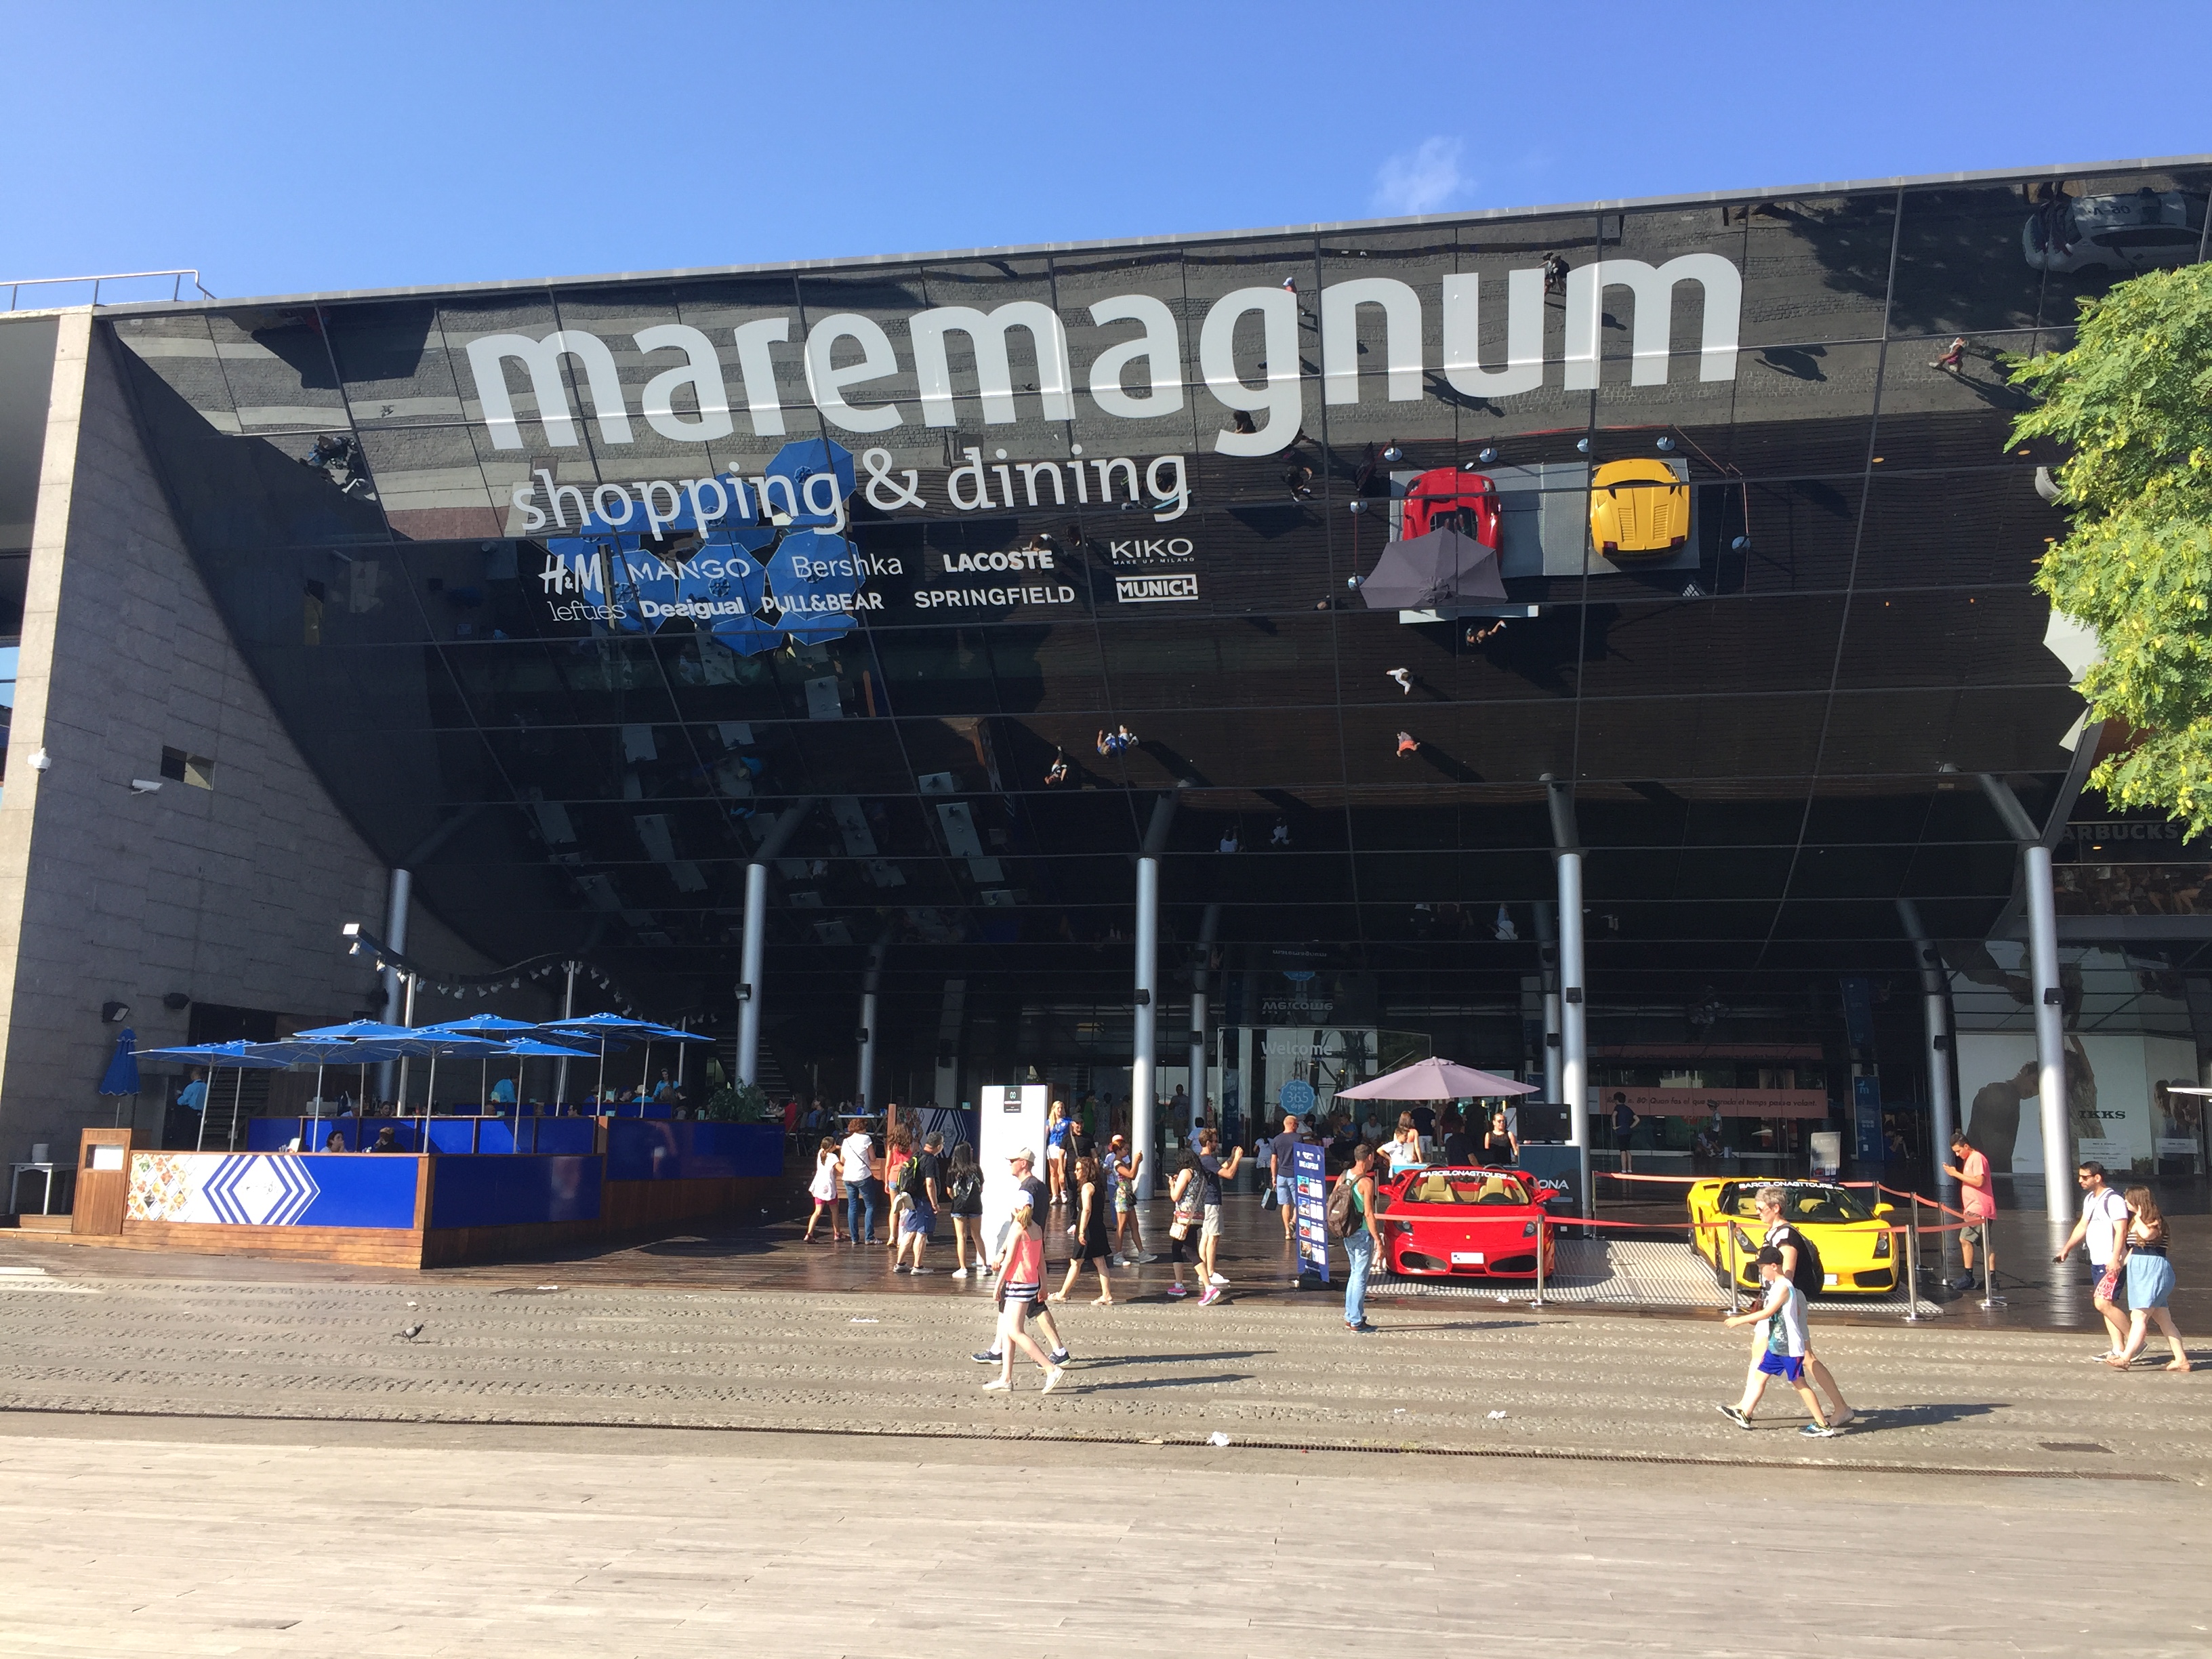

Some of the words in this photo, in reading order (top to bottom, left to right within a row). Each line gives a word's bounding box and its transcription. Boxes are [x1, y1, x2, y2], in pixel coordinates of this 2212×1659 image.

[466, 253, 1743, 457] maremagnum
[512, 462, 846, 536] shopping
[863, 447, 927, 511] &
[947, 445, 1191, 522] dining
[1111, 538, 1193, 559] KIKO
[626, 558, 751, 582] MANGO
[792, 555, 903, 579] Bershka
[943, 550, 1054, 573] LACOSTE
[538, 552, 605, 595] H&M
[914, 586, 1076, 609] SPRINGFIELD
[1116, 577, 1198, 600] MUNICH
[546, 600, 627, 621] lefties
[639, 596, 745, 620] Desigual
[760, 592, 885, 613] PULL&BEAR
[2062, 823, 2179, 840] ARBUCKS
[1261, 1041, 1333, 1056] Welcome
[1286, 1091, 1309, 1103] 365
[2078, 1110, 2126, 1120] IKKS
[1538, 1179, 1570, 1190] ONA
